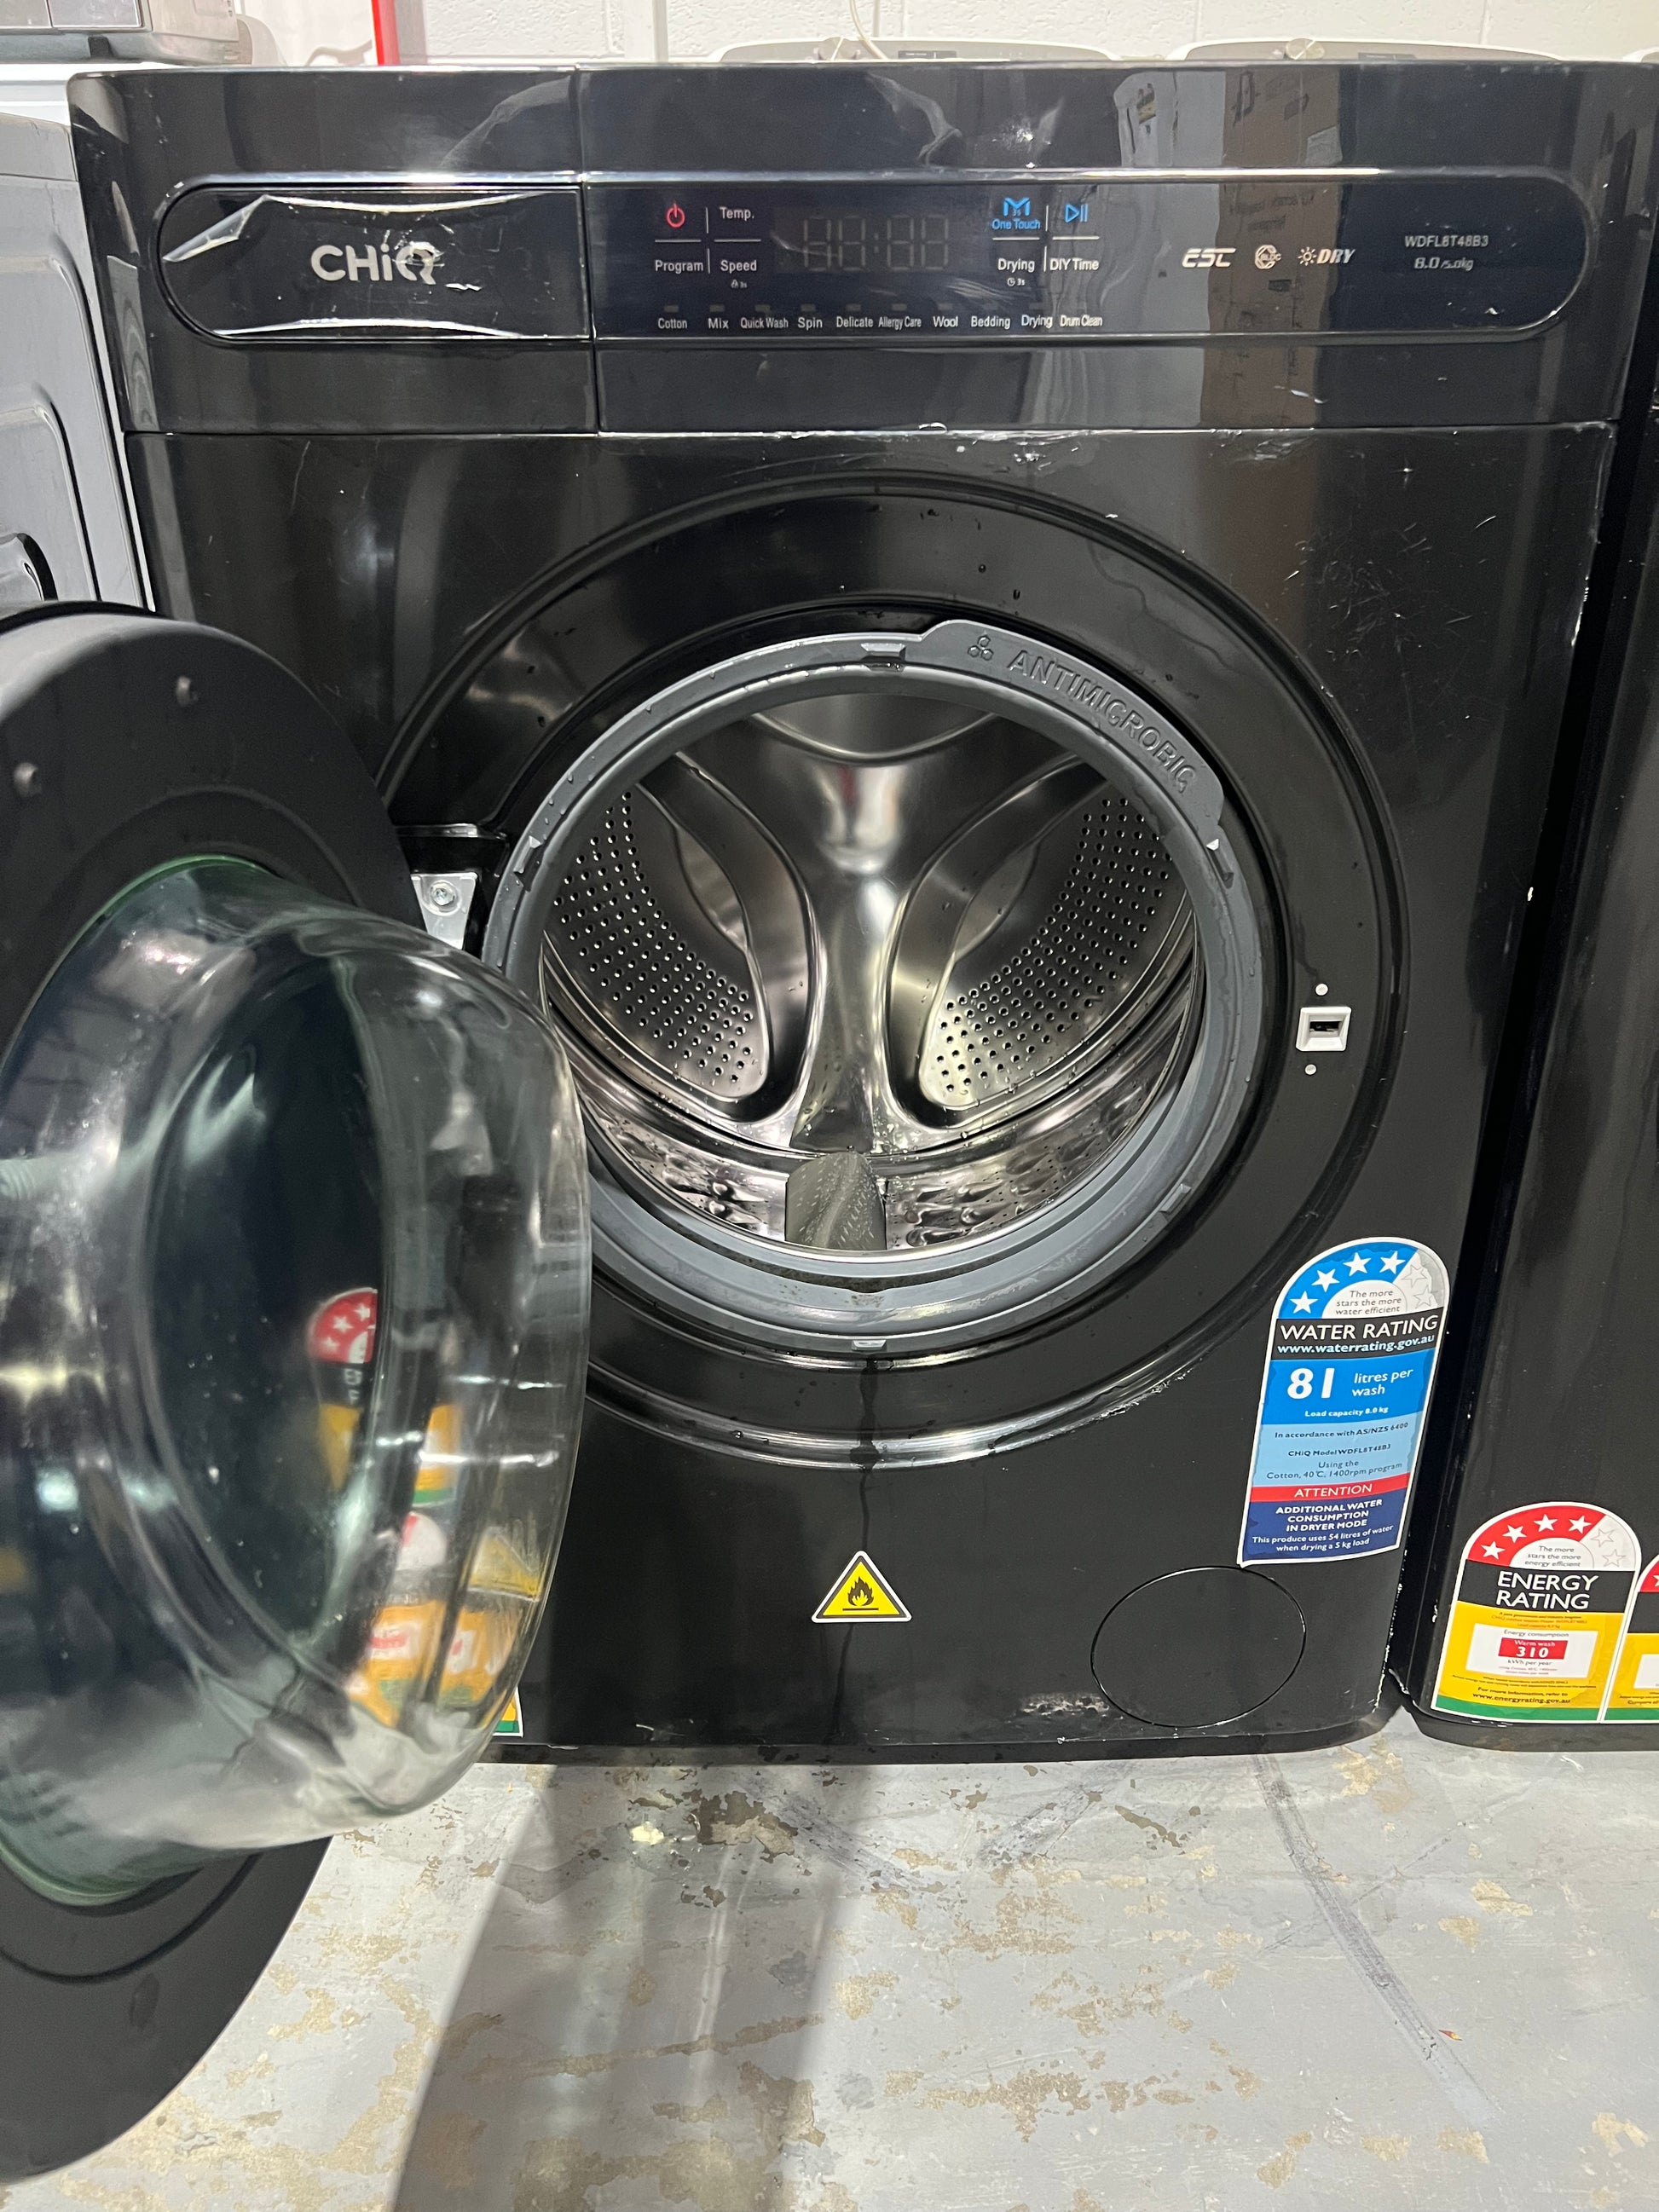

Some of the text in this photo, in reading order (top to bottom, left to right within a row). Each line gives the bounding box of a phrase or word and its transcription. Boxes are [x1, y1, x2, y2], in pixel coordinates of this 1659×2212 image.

[720, 206, 755, 221] Temp.
[991, 219, 1041, 230] One Touch
[1404, 234, 1489, 248] WDFL8T48B3
[1182, 247, 1236, 268] ESC
[1316, 249, 1356, 264] DRY
[655, 258, 704, 274] Program
[720, 258, 757, 274] Speed
[997, 258, 1035, 273] Drying
[1049, 258, 1099, 270] DIY Time
[657, 317, 688, 330] Cotton
[708, 317, 729, 330] Mix
[740, 317, 789, 329] Quick Wash
[797, 316, 823, 331] Spin
[836, 315, 874, 328] Delicate
[878, 315, 922, 331] Allergy Care
[933, 315, 958, 327] Wool
[971, 315, 1011, 330] Bedding
[1020, 315, 1053, 329] Drying
[1060, 314, 1103, 326] Drum Clean
[1007, 649, 1197, 794] ANTIMICROBIC
[1349, 1290, 1367, 1298] The
[1379, 1297, 1402, 1305] more
[1365, 1306, 1401, 1315] efficient
[1280, 1314, 1439, 1340] WATER RATING
[1277, 1335, 1435, 1354] www.waterrating.gov.au
[1354, 1368, 1413, 1383] litres per
[1351, 1384, 1385, 1397] wash
[1328, 1409, 1364, 1418] capacity
[1356, 1425, 1389, 1435] AS/NZS
[1267, 1471, 1302, 1480] Cotton,
[1329, 1469, 1367, 1478] 1400rpm
[1368, 1463, 1402, 1475] program
[1318, 1461, 1343, 1470] Using
[1294, 1483, 1373, 1498] ATTENTION
[1275, 1499, 1383, 1515] ADDITIONAL WATER
[1287, 1510, 1369, 1523] CONSUMPTION
[1336, 1519, 1367, 1529] MODE
[1271, 1535, 1307, 1545] produce
[1361, 1529, 1373, 1538] of
[1373, 1525, 1394, 1534] water
[1300, 1543, 1327, 1552] drying
[1342, 1540, 1351, 1549] kg
[1352, 1538, 1370, 1546] load
[1497, 1570, 1599, 1591] ENERGY
[1495, 1590, 1591, 1609] RATING
[1514, 1639, 1536, 1648] Warm
[1516, 1646, 1549, 1659] 310
[1472, 1692, 1570, 1704] www.energyrating.gov.au
